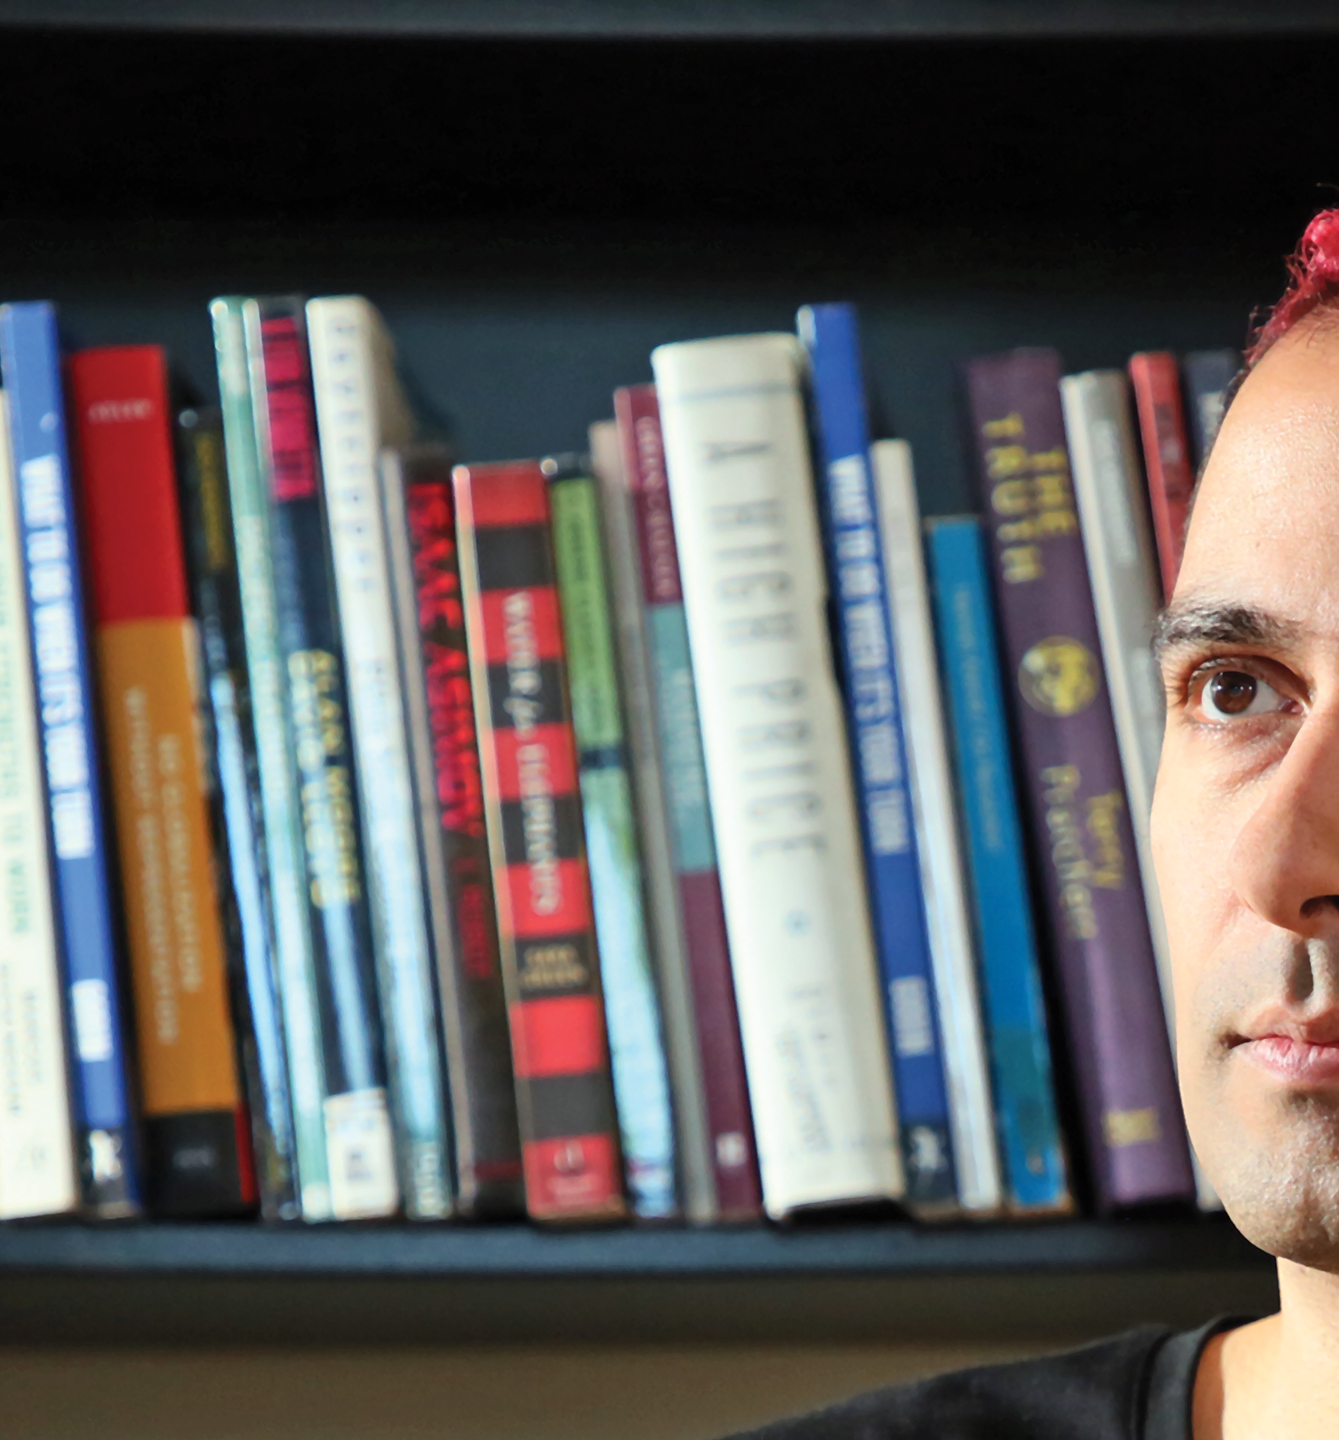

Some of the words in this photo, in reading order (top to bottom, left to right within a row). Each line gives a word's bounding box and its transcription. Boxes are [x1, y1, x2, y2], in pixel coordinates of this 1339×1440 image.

[827, 454, 868, 521] WHAT
[981, 412, 1043, 585] TRUTH
[1028, 448, 1078, 535] THE
[26, 529, 68, 563] TO
[408, 482, 459, 629] ISAAC
[710, 498, 798, 641] HIGH
[835, 524, 875, 561] TO
[840, 561, 879, 601] DO
[34, 604, 78, 670] WHEN
[504, 591, 541, 696] WATER
[846, 602, 888, 667] WHEN
[40, 671, 82, 722] IT'S
[853, 667, 894, 723] IT'S
[427, 646, 482, 837] ASIMOV
[733, 675, 829, 857] PRICE
[859, 724, 900, 787] YOUR
[517, 743, 562, 918] ELEPHANTS
[867, 788, 908, 854] TURN
